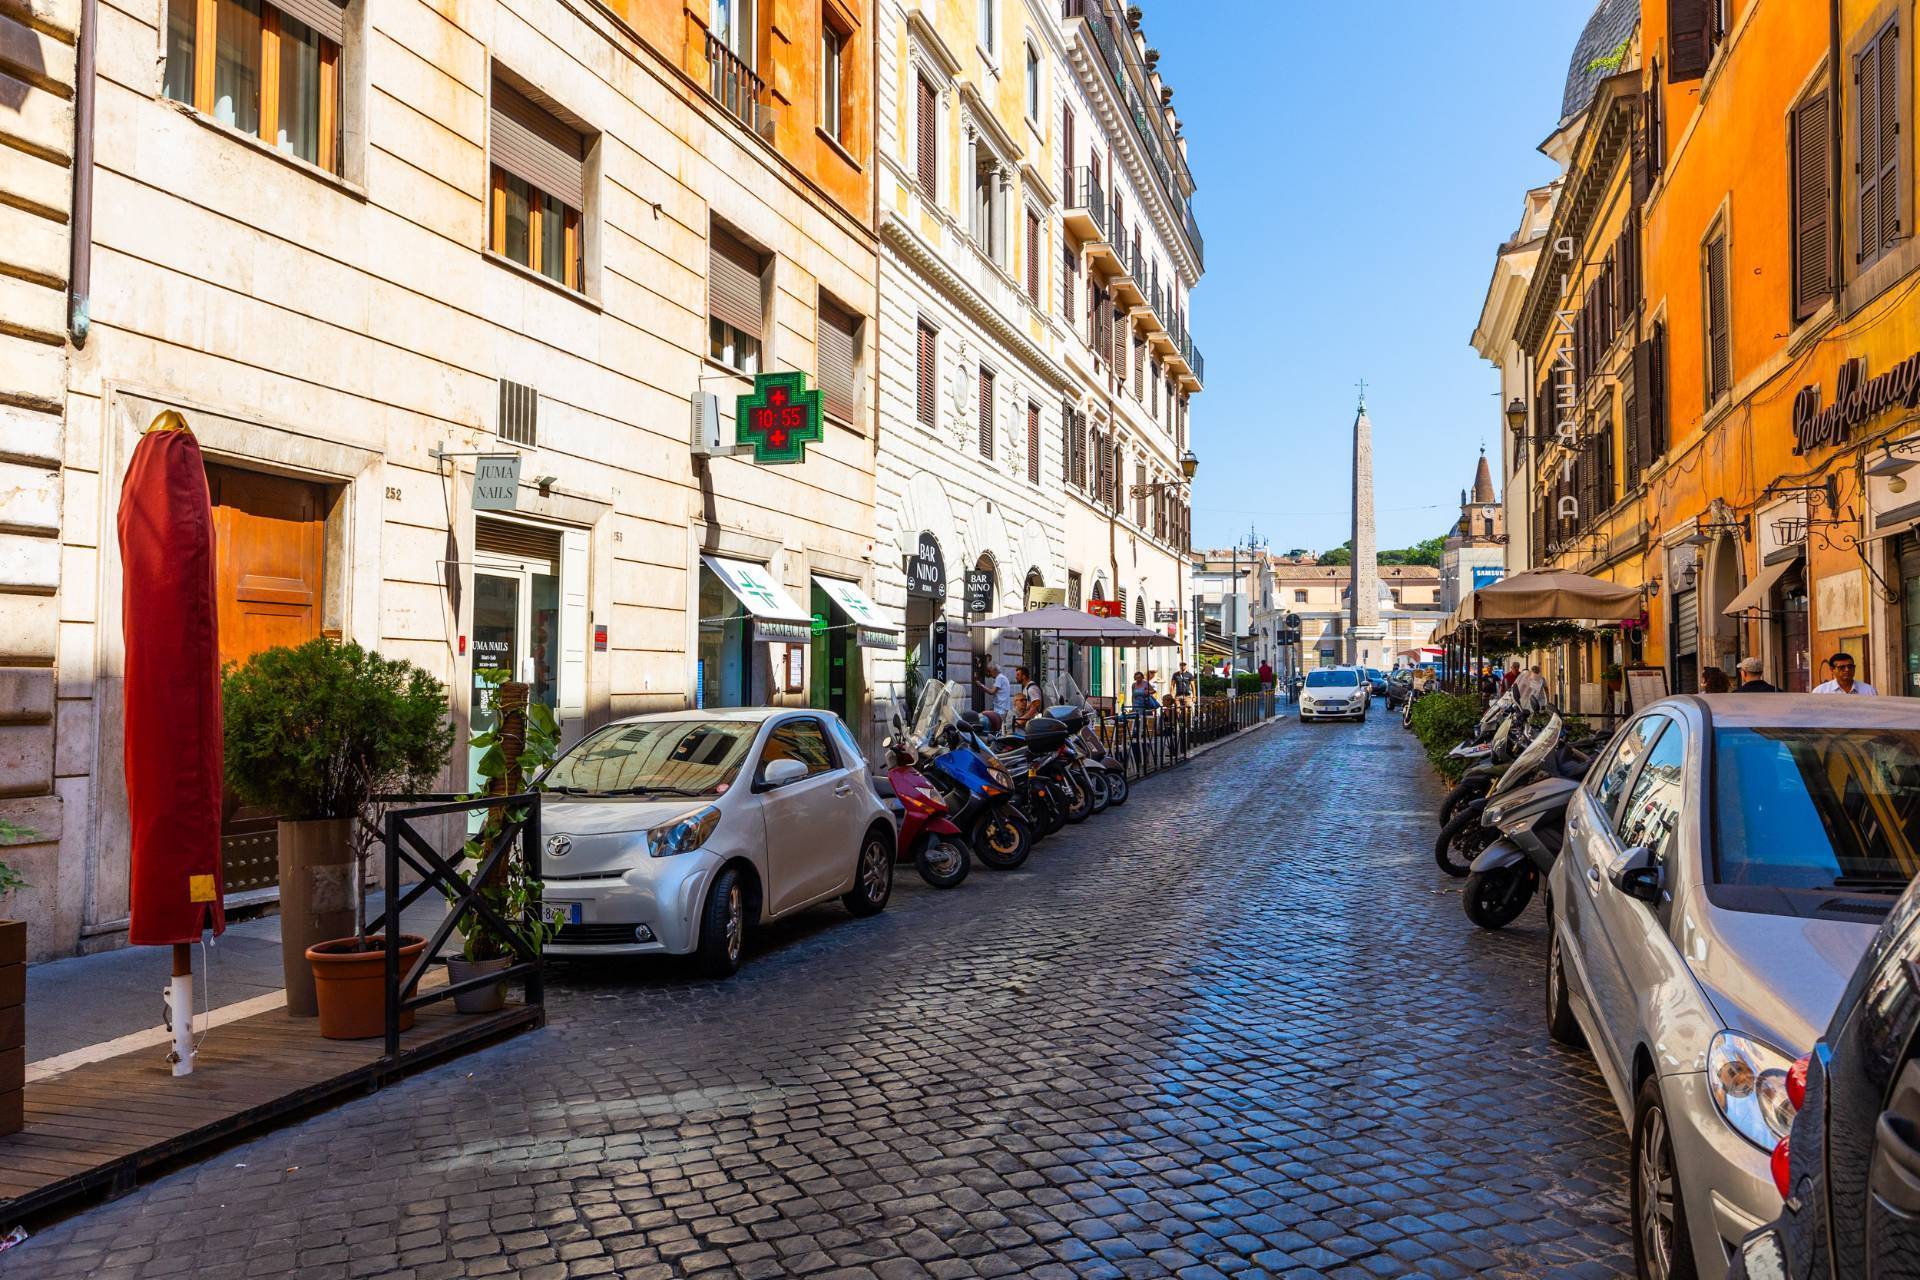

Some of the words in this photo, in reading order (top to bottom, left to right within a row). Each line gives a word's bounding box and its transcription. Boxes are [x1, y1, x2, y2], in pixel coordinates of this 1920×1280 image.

[756, 407, 801, 428] 10:55
[478, 465, 513, 480] JUMA
[385, 486, 402, 501] 252
[478, 486, 513, 499] NAILS
[920, 543, 936, 563] BAR
[916, 563, 939, 583] NINO
[970, 574, 987, 583] BAR
[967, 583, 991, 592] NINO
[1030, 601, 1054, 610] PIZ
[759, 622, 807, 638] FARMACIA
[471, 640, 488, 651] UMA
[489, 641, 509, 652] NAILS
[936, 643, 945, 680] BAR
